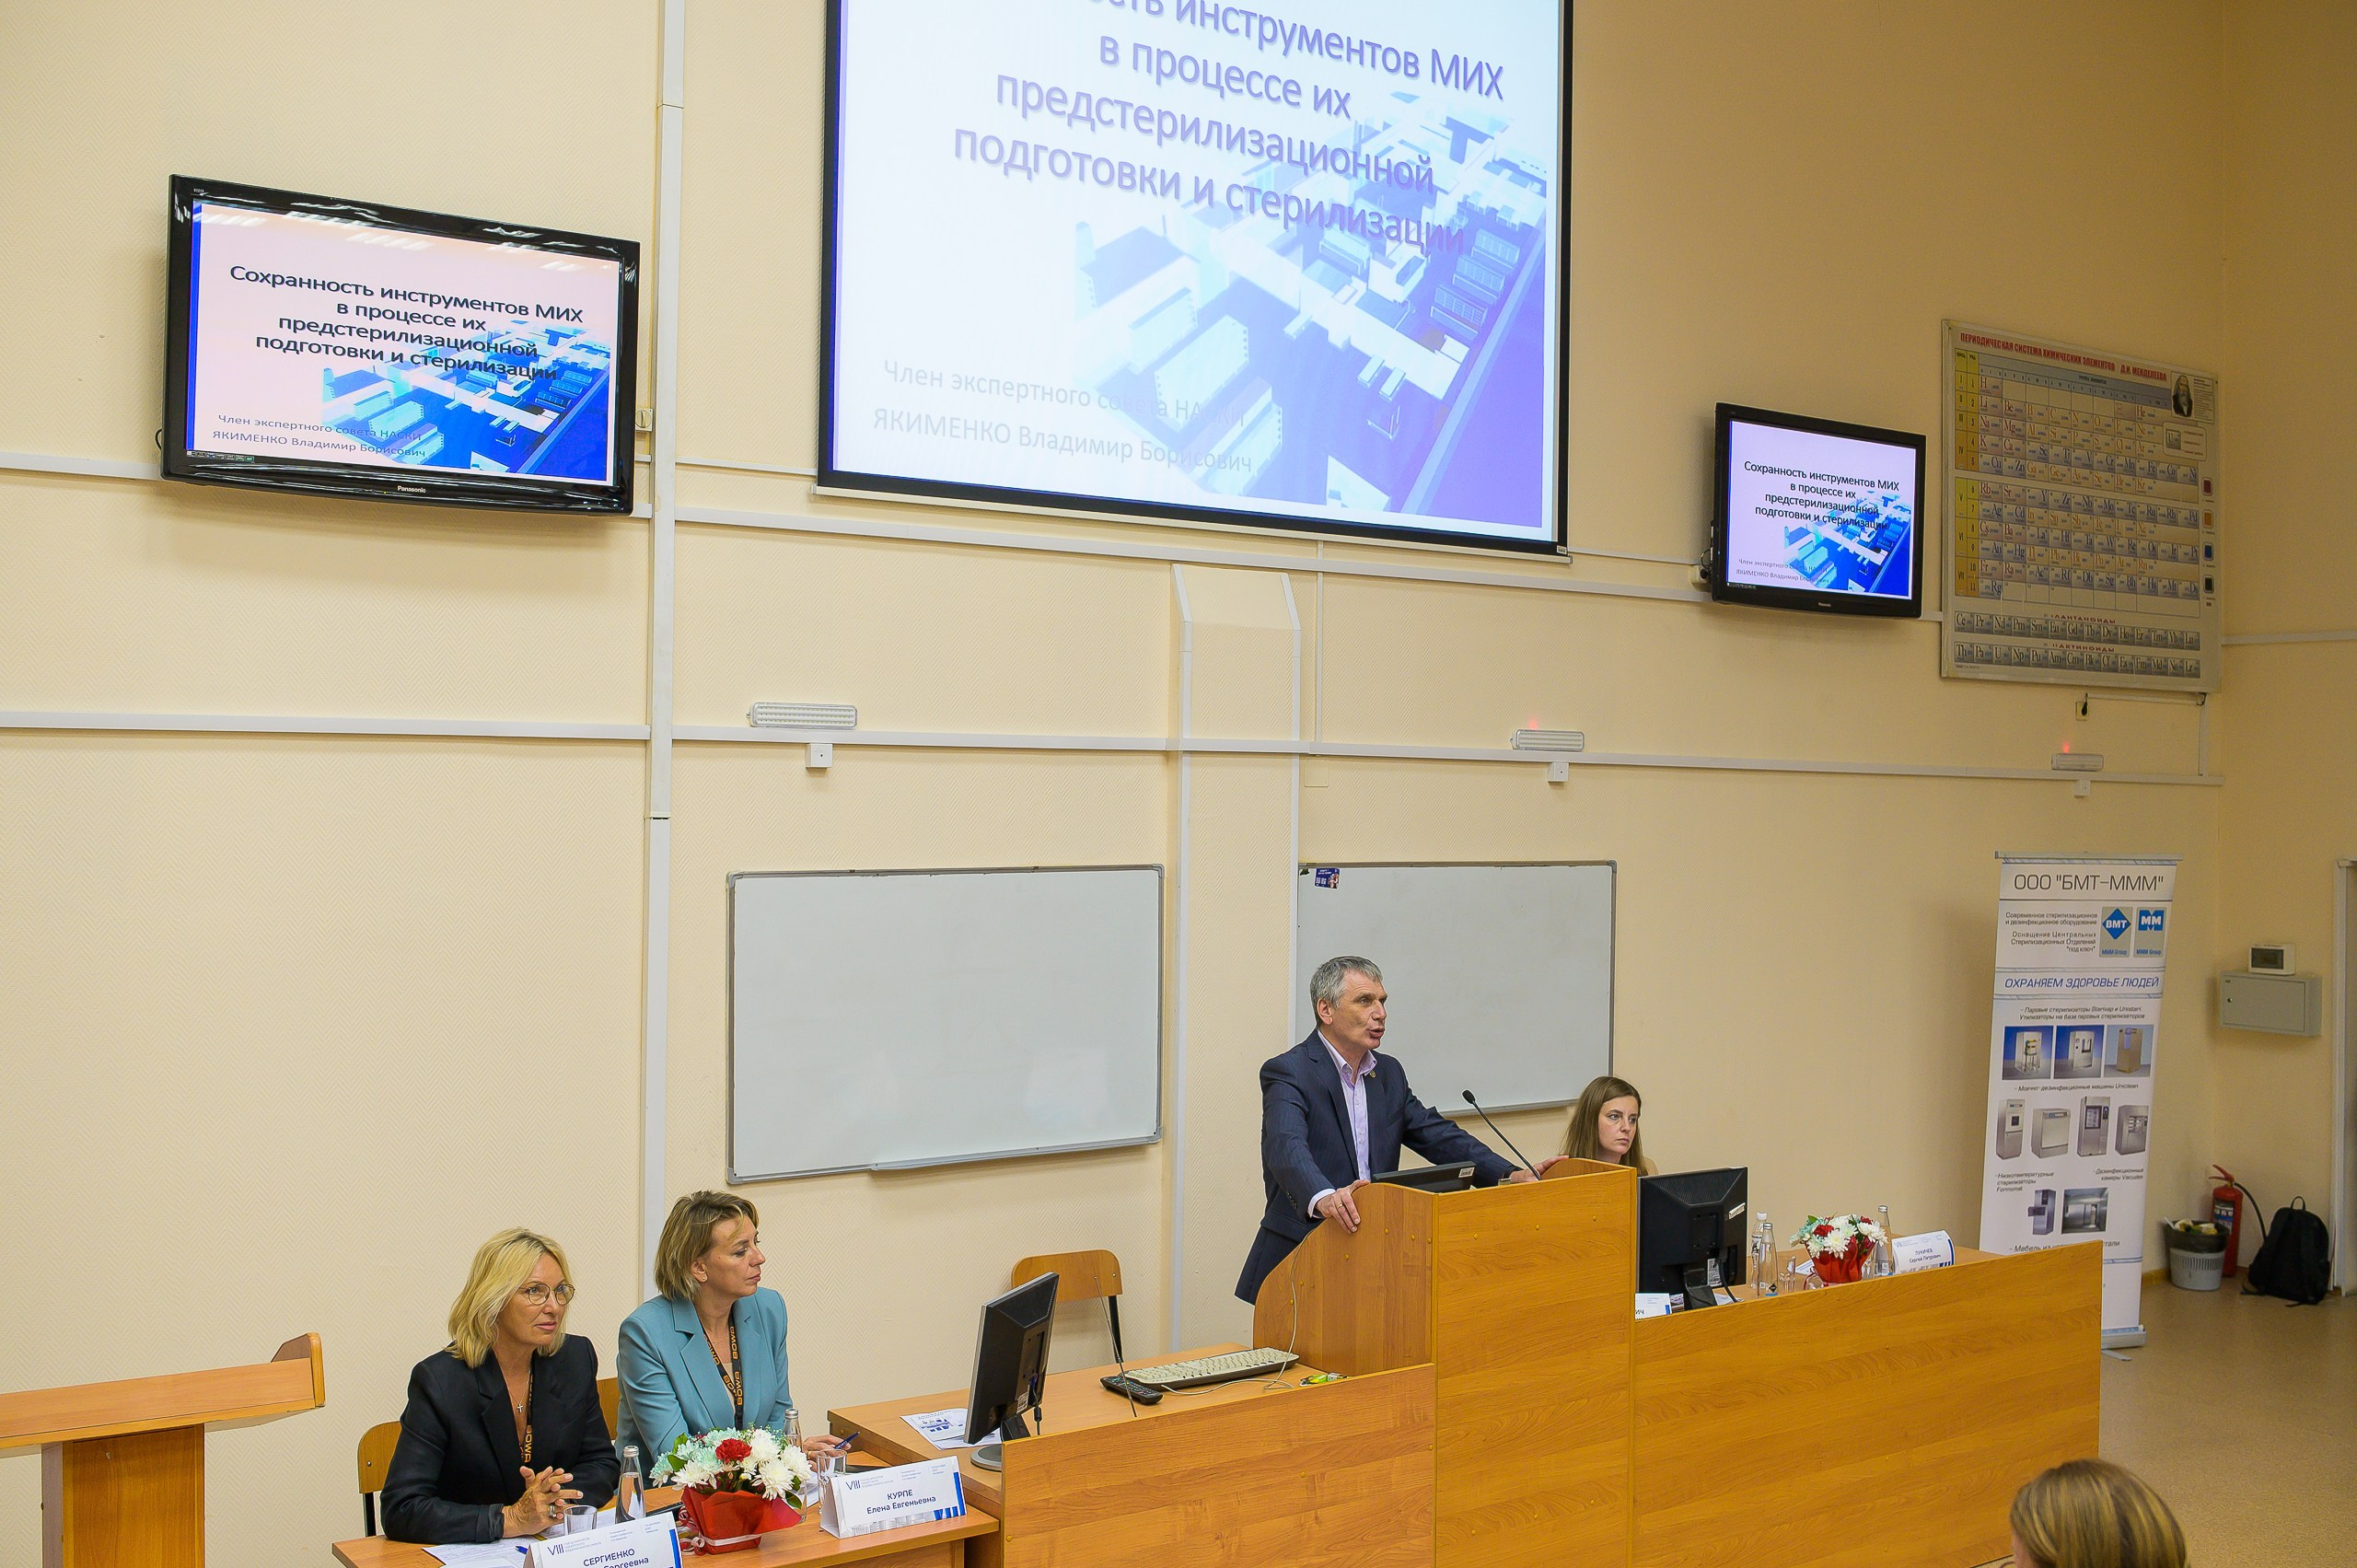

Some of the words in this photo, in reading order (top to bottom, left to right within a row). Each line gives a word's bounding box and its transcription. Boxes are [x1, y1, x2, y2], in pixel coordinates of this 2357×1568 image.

[1176, 0, 1420, 78] инструментов
[1431, 48, 1504, 101] МИХ
[1099, 35, 1119, 65] в
[1132, 42, 1302, 107] процессе
[1313, 85, 1351, 120] их
[997, 74, 1434, 194] предстерилизационной
[955, 128, 1180, 201] подготовки
[1193, 175, 1214, 207] и
[1225, 182, 1465, 257] стерилизации
[230, 265, 374, 296] Сохранность
[380, 287, 529, 316] инструментов
[535, 304, 584, 323] МИХ
[337, 303, 348, 314] в
[355, 305, 457, 327] процессе
[462, 318, 486, 331] их
[279, 317, 538, 357] предстерилизационной
[256, 336, 384, 361] подготовки
[390, 351, 404, 364] и
[410, 354, 557, 380] стерилизации
[1960, 332, 2013, 351] ПЕРИОДИЧЕСКАЯ
[2014, 343, 2042, 356] СИСТЕМА
[2042, 348, 2082, 364] ХИМИЧЕСКИХ
[2082, 356, 2116, 371] ЭЛЕМЕНТОВ
[2131, 366, 2167, 381] МЕНДЕЛЕЕВА
[884, 359, 943, 388] Член
[951, 373, 1090, 407] экспертного
[218, 414, 250, 425] Член
[254, 419, 332, 434] экспертного
[335, 426, 377, 437] совета
[380, 429, 422, 441] НАСКИ
[874, 408, 1011, 444] ЯКИМЕНКО
[1018, 425, 1132, 463] Владимир
[1141, 440, 1251, 473] Борисович
[2003, 419, 2015, 435] Mg
[212, 430, 288, 445] ЯКИМЕНКО
[291, 437, 356, 453] Владимир
[360, 441, 425, 458] Борисович
[1980, 435, 1987, 447] K
[2003, 438, 2014, 451] Ca
[1744, 460, 1807, 479] Сохранность
[1809, 471, 1875, 488] инструментов
[1877, 479, 1899, 492] МИХ
[1991, 456, 2002, 469] Cu
[2014, 459, 2025, 472] Zn
[397, 485, 426, 494] Panasonic
[1790, 482, 1796, 491] в
[1798, 484, 1843, 497] процессе
[1845, 491, 1856, 499] их
[1980, 482, 1991, 494] Rb
[1755, 506, 1811, 521] подготовки
[1813, 514, 1820, 522] и
[1822, 515, 1887, 531] стерилизации
[1765, 494, 1879, 516] предстерилизационной
[2014, 874, 2051, 890] ООО
[2004, 978, 2063, 988] ОХРАНЯЕМ
[2065, 977, 2119, 990] ЗДОРОВЬЕ
[2120, 976, 2159, 989] ЛЮДЕЙ
[734, 1371, 743, 1406] BOWA
[524, 1424, 532, 1463] BOWA
[845, 1479, 861, 1491] VIII
[887, 1489, 913, 1500] КУРПЕ
[866, 1504, 891, 1514] Елена
[892, 1496, 936, 1510] Евгеньевна
[547, 1543, 564, 1556] VIII
[583, 1548, 635, 1567] СЕРГИЕНКО
